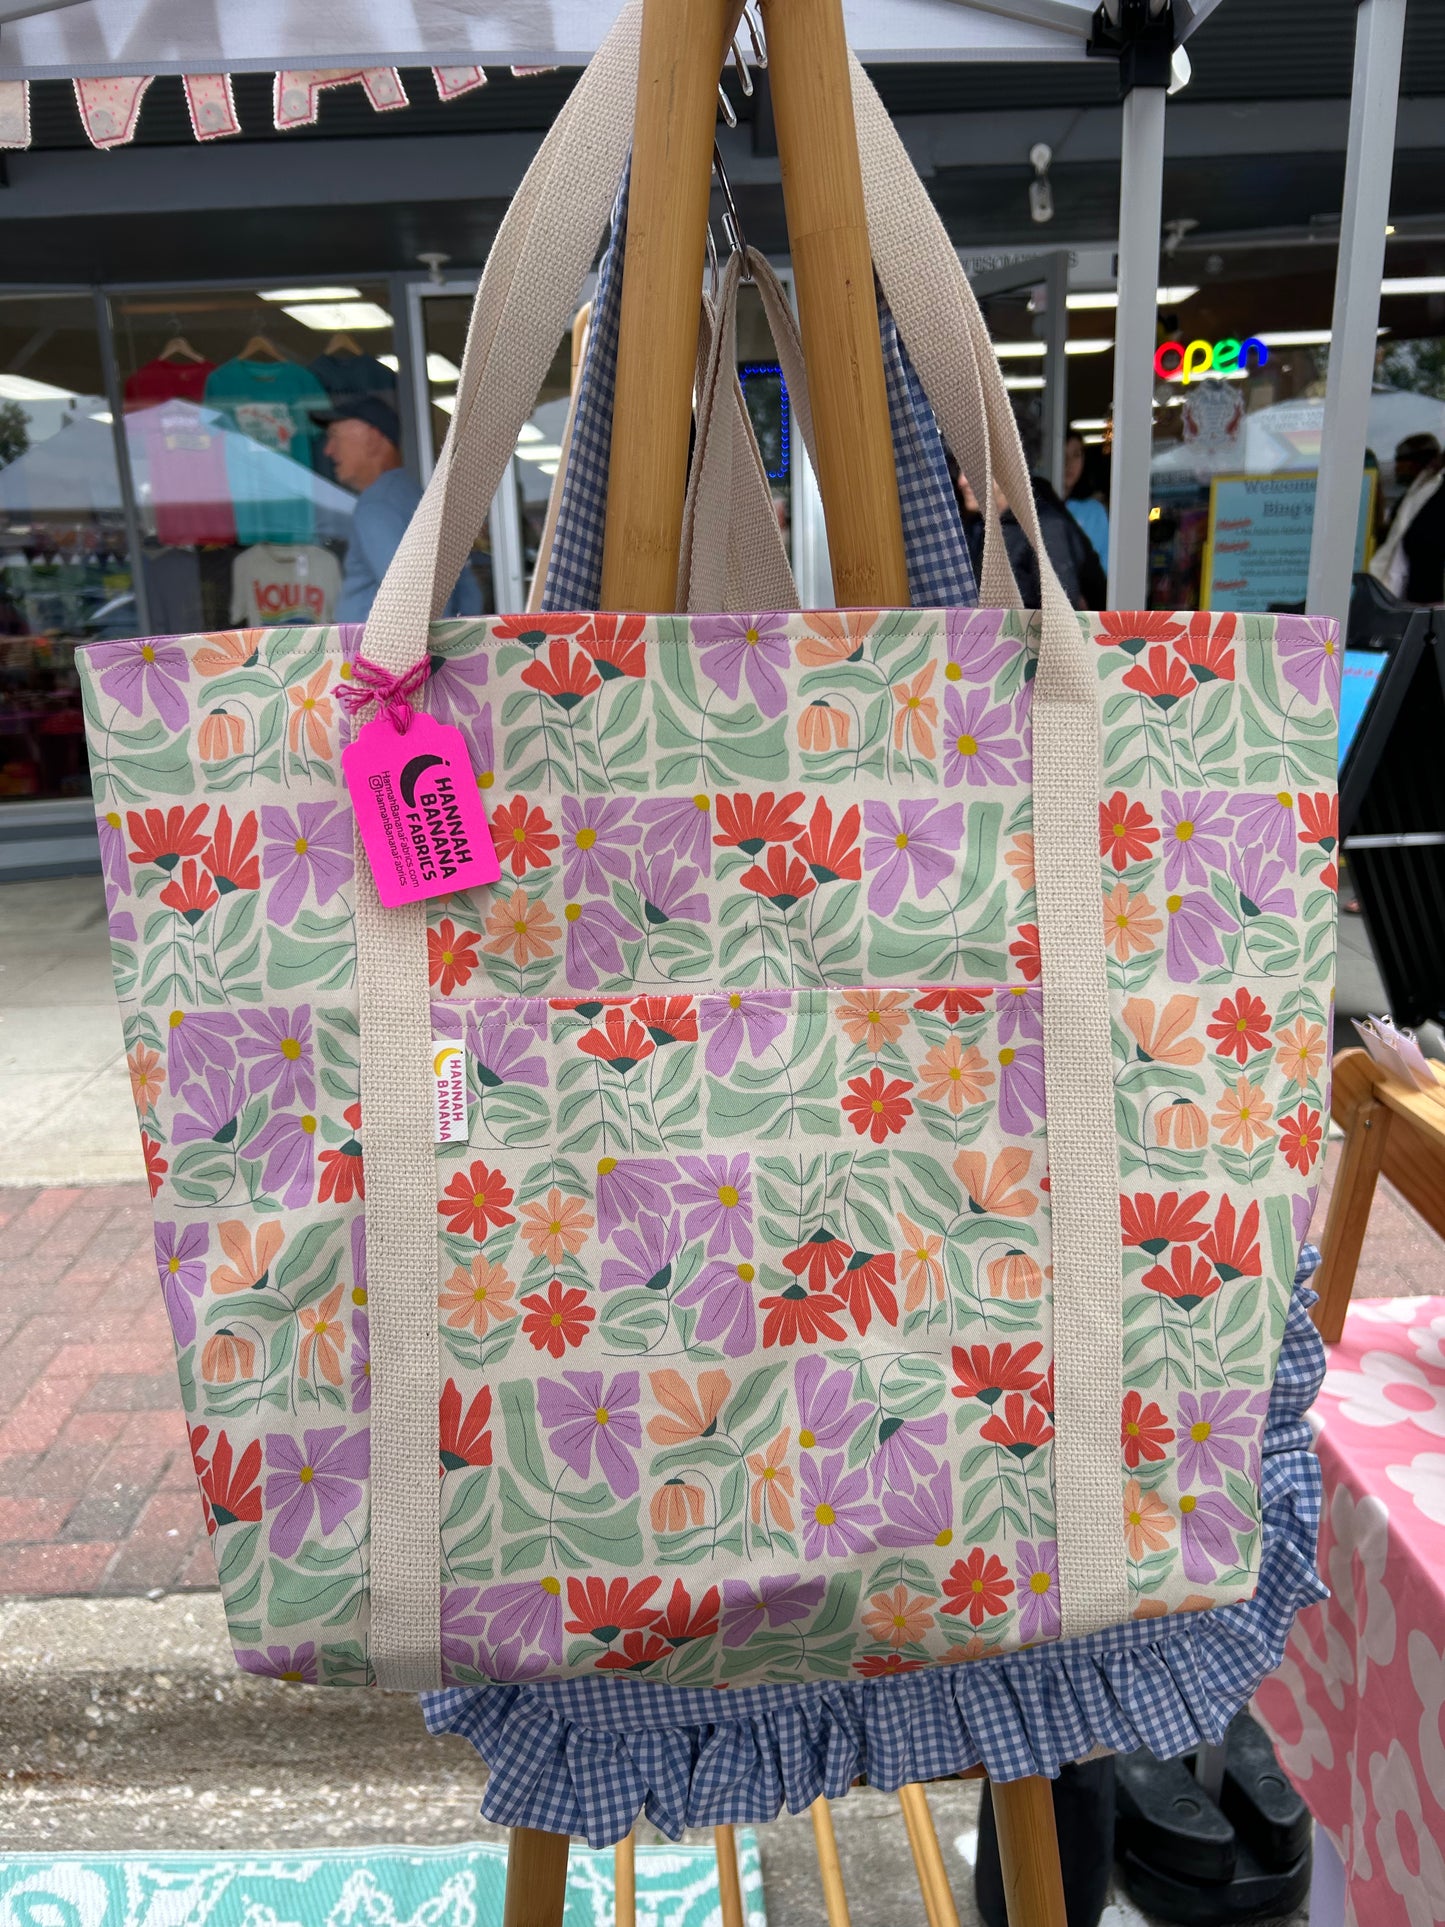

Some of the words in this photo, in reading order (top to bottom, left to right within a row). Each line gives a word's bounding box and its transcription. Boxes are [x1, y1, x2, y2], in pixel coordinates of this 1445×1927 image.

[1154, 337, 1269, 384] open
[374, 789, 408, 887] HannahBananaFabrics
[381, 770, 420, 888] HannahBananaFabrics.com
[406, 813, 437, 881] FABRICS
[420, 793, 457, 880] BANANA
[434, 777, 473, 864] HANNAH
[437, 1080, 451, 1141] BANANA
[450, 1059, 464, 1122] HANNAH
